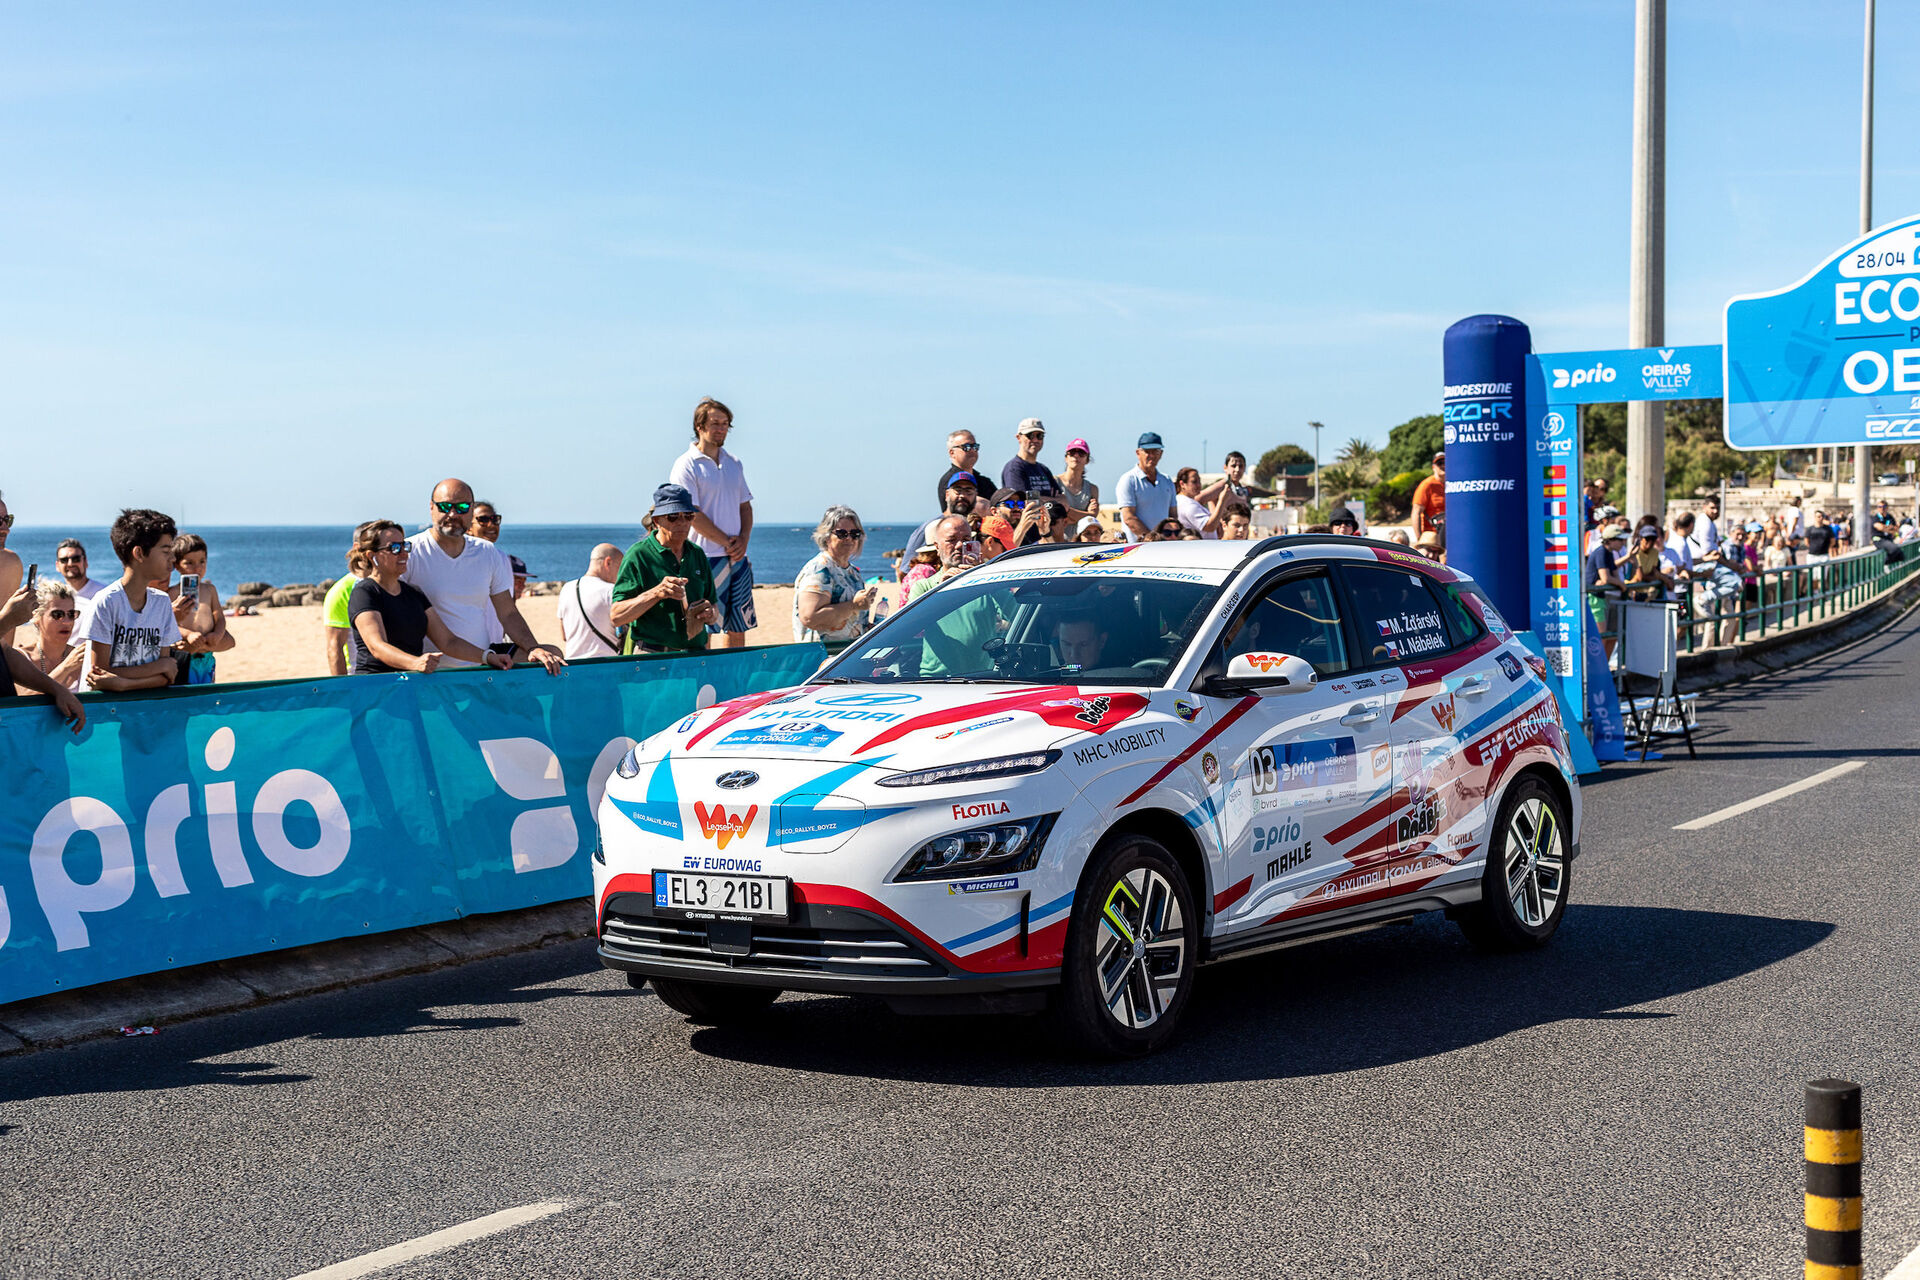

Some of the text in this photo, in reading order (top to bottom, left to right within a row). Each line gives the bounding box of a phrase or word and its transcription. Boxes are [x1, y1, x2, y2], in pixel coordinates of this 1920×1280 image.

[1857, 251, 1905, 269] 28/04
[1570, 362, 1617, 388] prio
[1641, 363, 1692, 377] OEIRAS
[1641, 375, 1692, 389] VALLEY
[1458, 422, 1500, 433] FIA ECO
[1458, 433, 1490, 443] RALLY
[1493, 432, 1515, 441] CUP
[986, 568, 1204, 582] HYUNDAI KONA electric
[1388, 618, 1404, 635] M.
[1398, 633, 1446, 656] J. Nábělek
[748, 710, 906, 723] HYUNDAI
[1505, 700, 1558, 750] EUROWAG
[778, 721, 812, 732] 03
[1073, 728, 1168, 767] MHC MOBILITY
[1250, 747, 1278, 794] 03
[1291, 757, 1315, 781] prio
[706, 821, 745, 833] LeasePlan
[1266, 816, 1301, 851] prio
[29, 725, 352, 953] prio
[704, 857, 762, 872] EUROWAG
[1266, 841, 1312, 881] MAHLE
[965, 879, 1016, 890] MICHELIN
[1339, 870, 1382, 894] HYUNDAI
[1384, 861, 1424, 880] KONA
[657, 893, 668, 903] CZ
[671, 877, 708, 906] EL3
